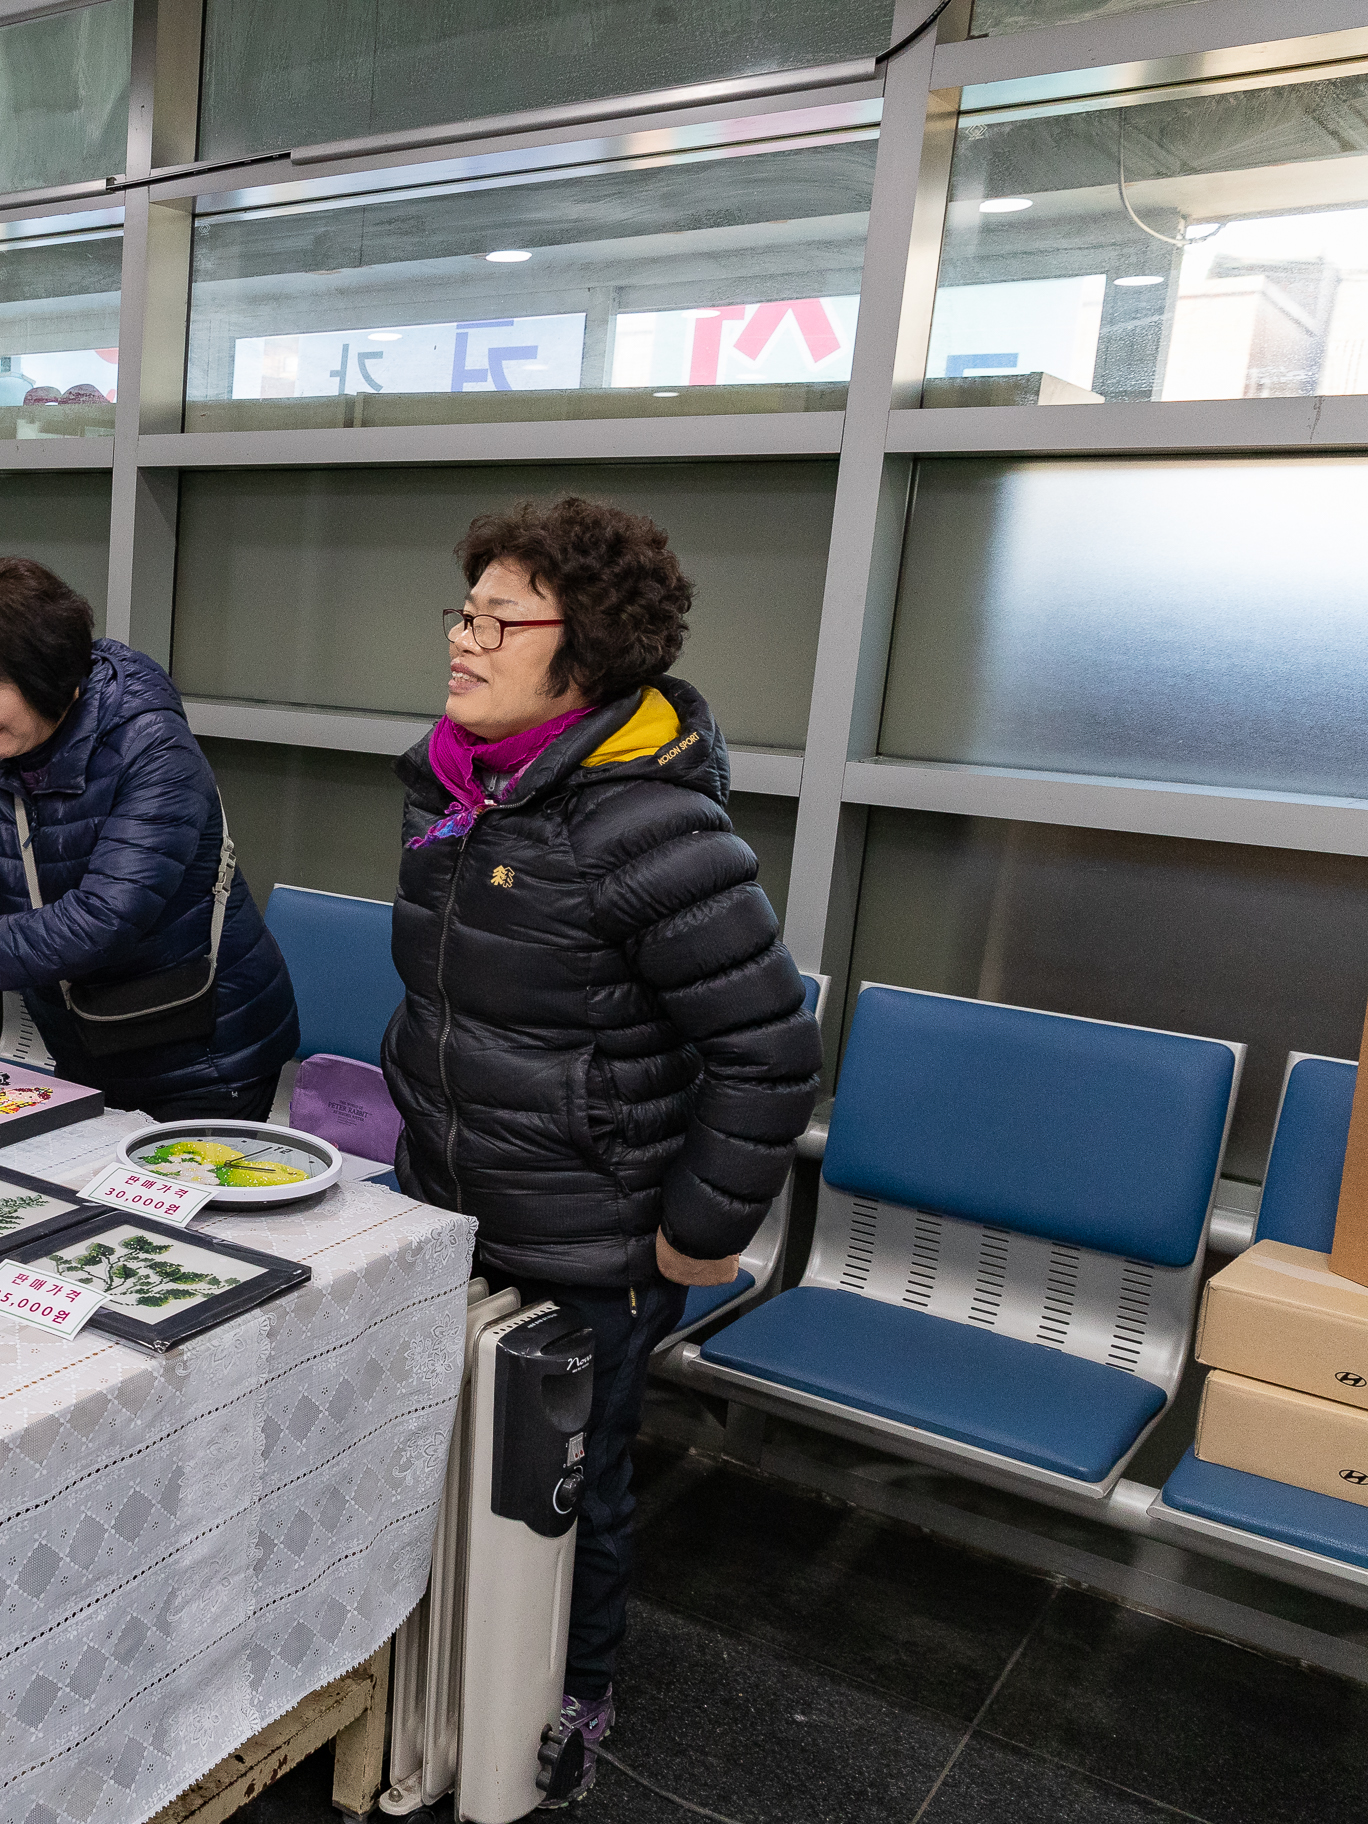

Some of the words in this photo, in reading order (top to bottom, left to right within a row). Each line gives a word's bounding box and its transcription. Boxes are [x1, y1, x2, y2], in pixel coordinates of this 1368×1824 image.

[657, 746, 681, 766] KOLON
[678, 732, 700, 750] SPORT
[328, 1101, 347, 1112] PETER
[348, 1107, 369, 1118] RABBIT
[125, 1175, 189, 1198] 판매가격
[105, 1187, 180, 1215] 30,000원
[12, 1273, 82, 1303] 판매가격
